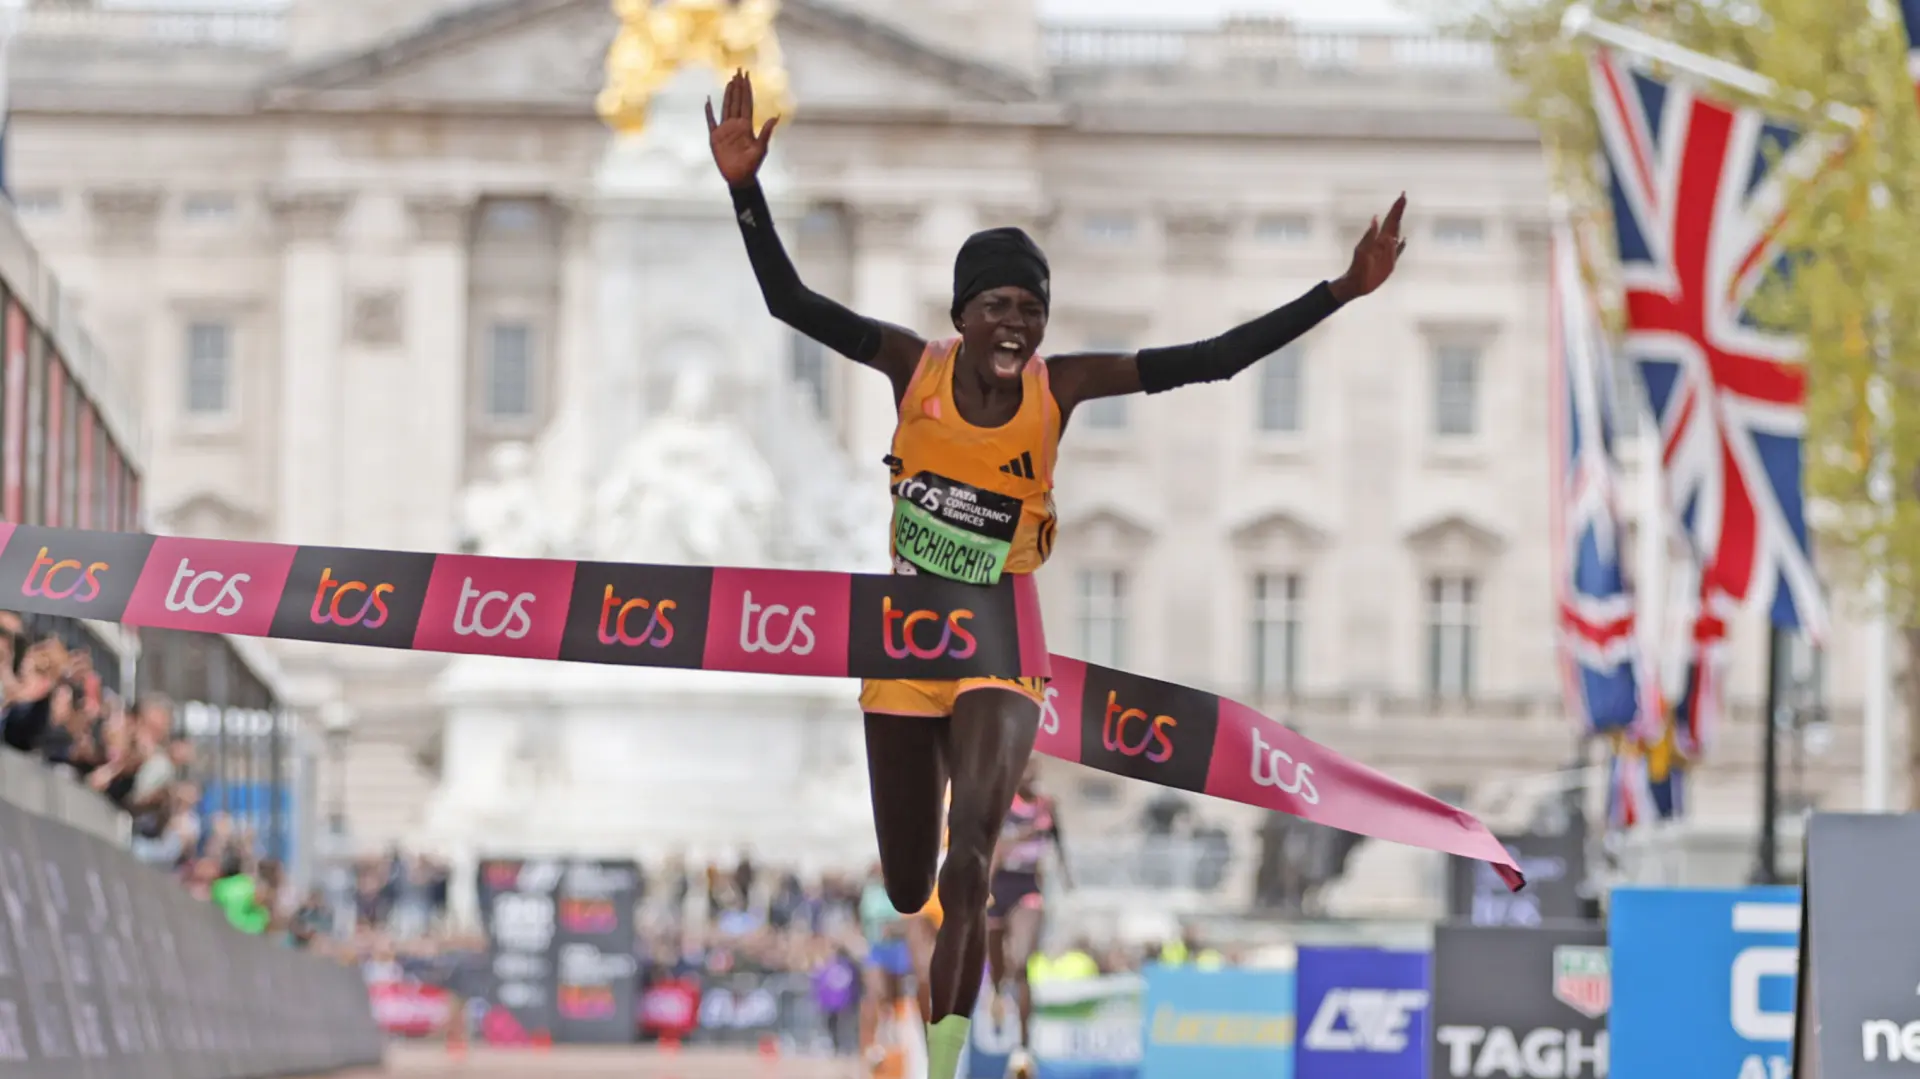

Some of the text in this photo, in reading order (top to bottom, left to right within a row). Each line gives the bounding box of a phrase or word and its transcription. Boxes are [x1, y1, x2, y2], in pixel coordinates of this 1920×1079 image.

[942, 507, 984, 527] SERVICES
[945, 497, 1012, 523] CONSULTANCY
[949, 486, 977, 503] TATA
[21, 546, 108, 602] tcs
[164, 557, 250, 616] tcs
[310, 567, 394, 629] tcs
[453, 576, 536, 640] tcs
[597, 583, 676, 648] tcs
[739, 589, 816, 655] tcs
[882, 595, 977, 659] tcs
[1102, 689, 1177, 763] tcs
[1250, 726, 1320, 804] tcs
